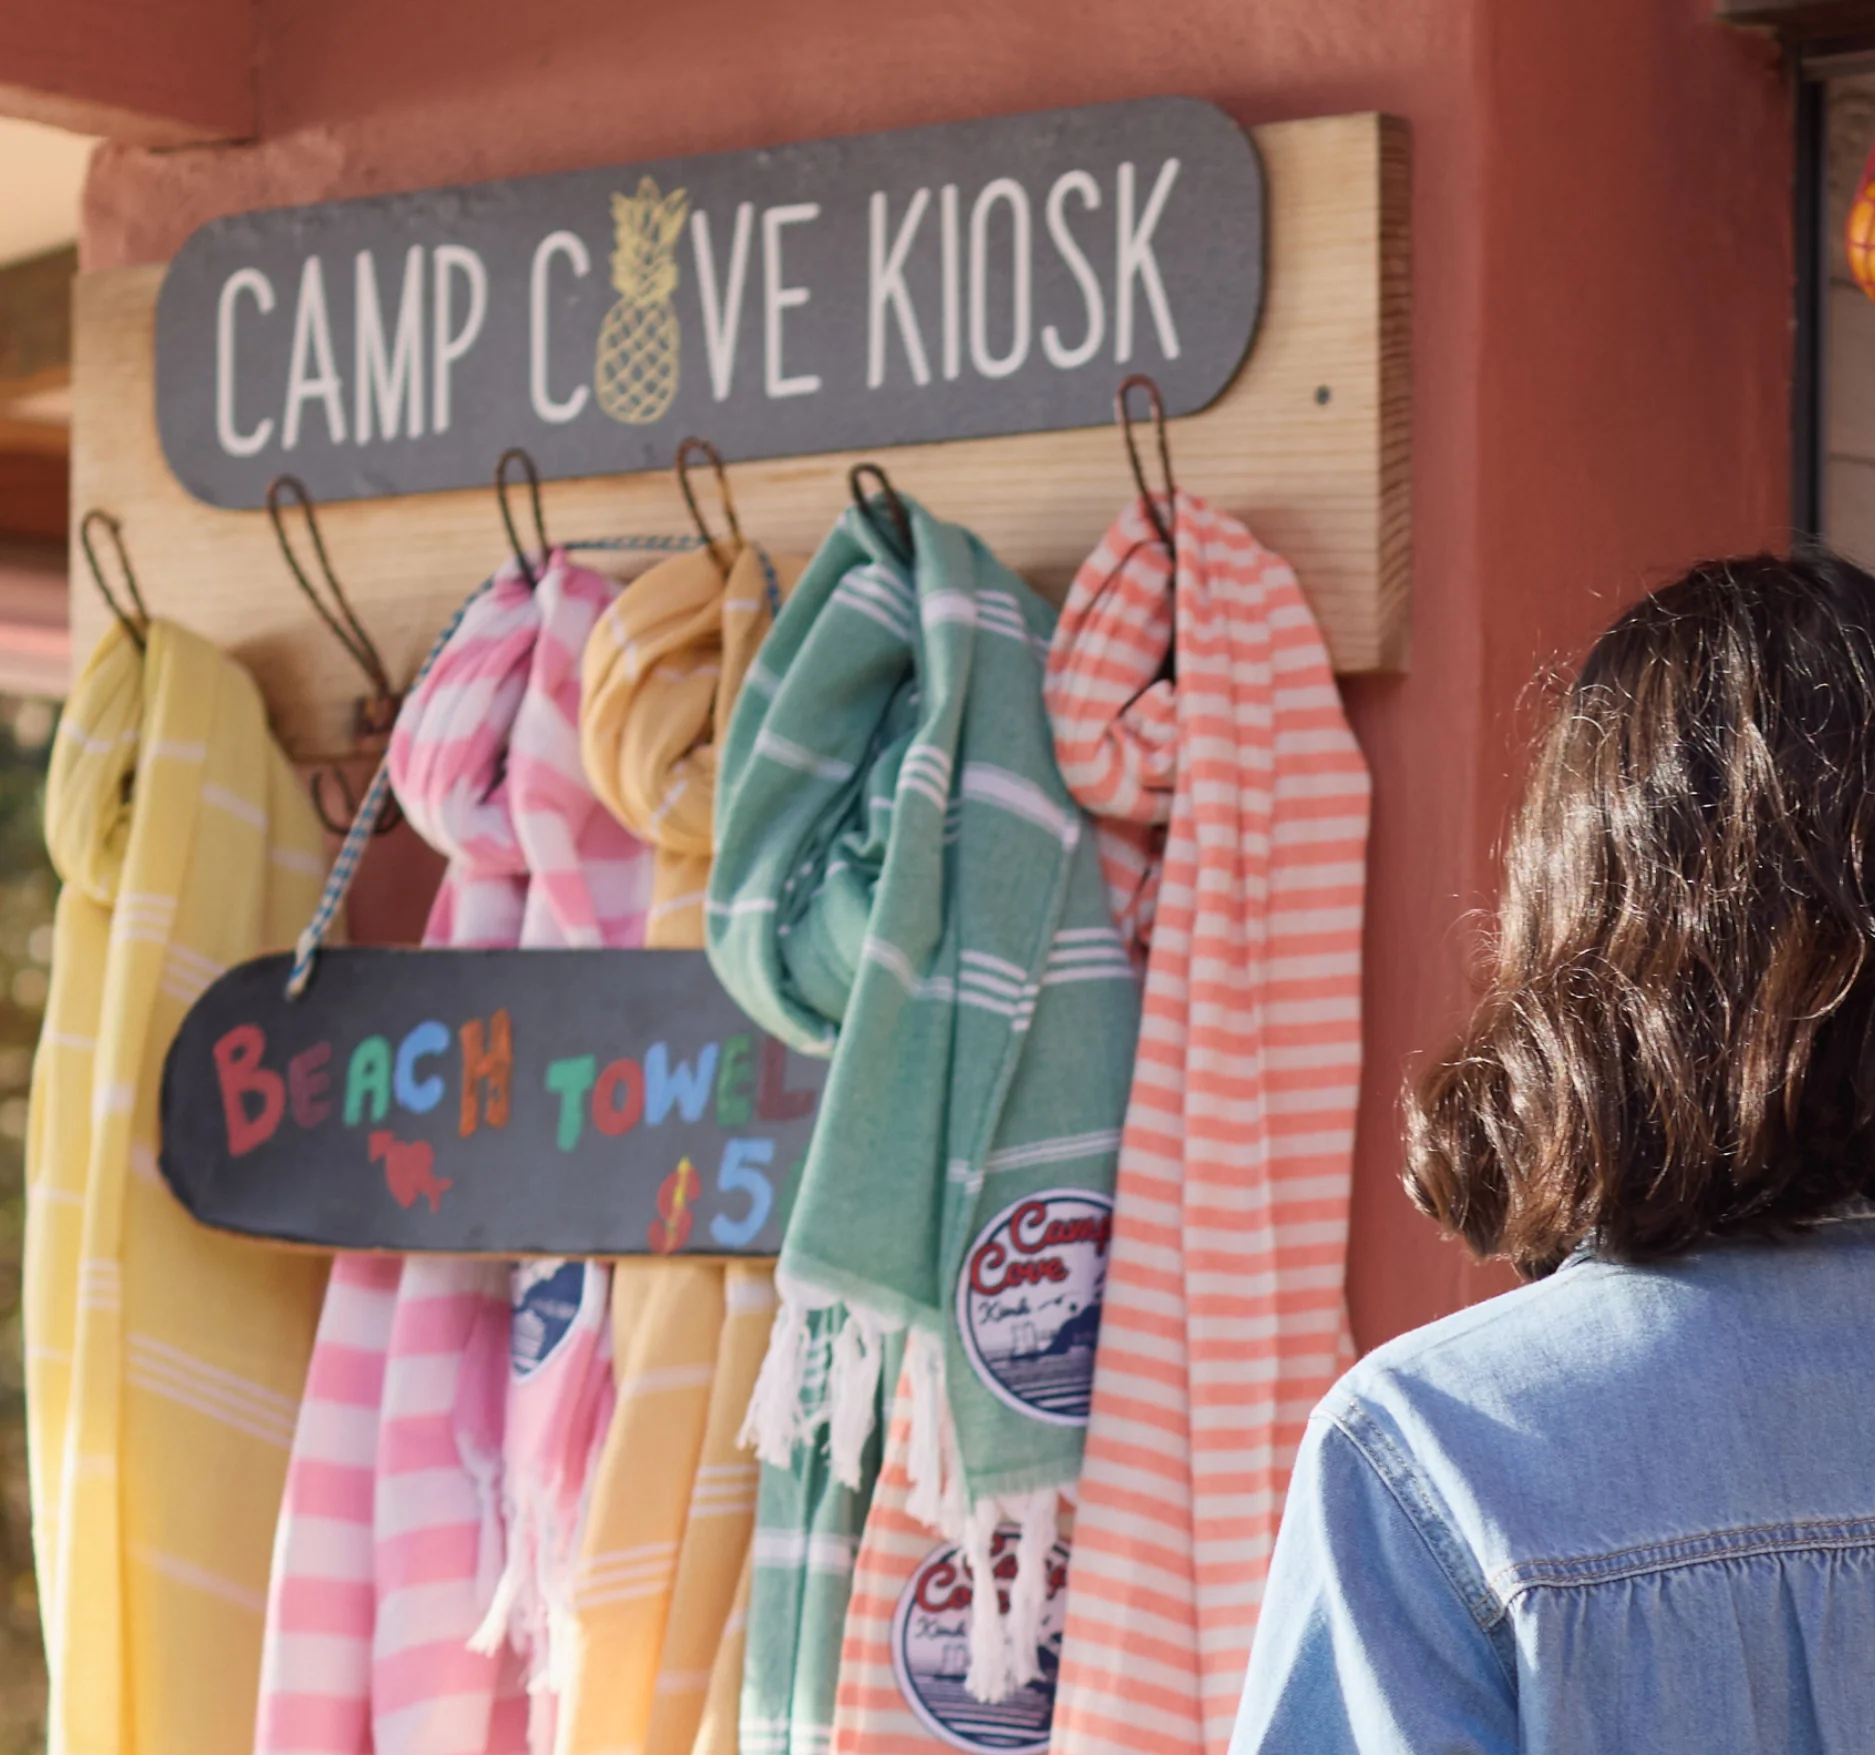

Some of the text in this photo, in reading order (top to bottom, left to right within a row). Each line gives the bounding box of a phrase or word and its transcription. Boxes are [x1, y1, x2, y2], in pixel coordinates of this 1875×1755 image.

[216, 243, 488, 457] CAMP
[867, 157, 1181, 389] KIOSK
[212, 1008, 817, 1158] BEACH TOWEL
[970, 1242, 1070, 1297] Cove
